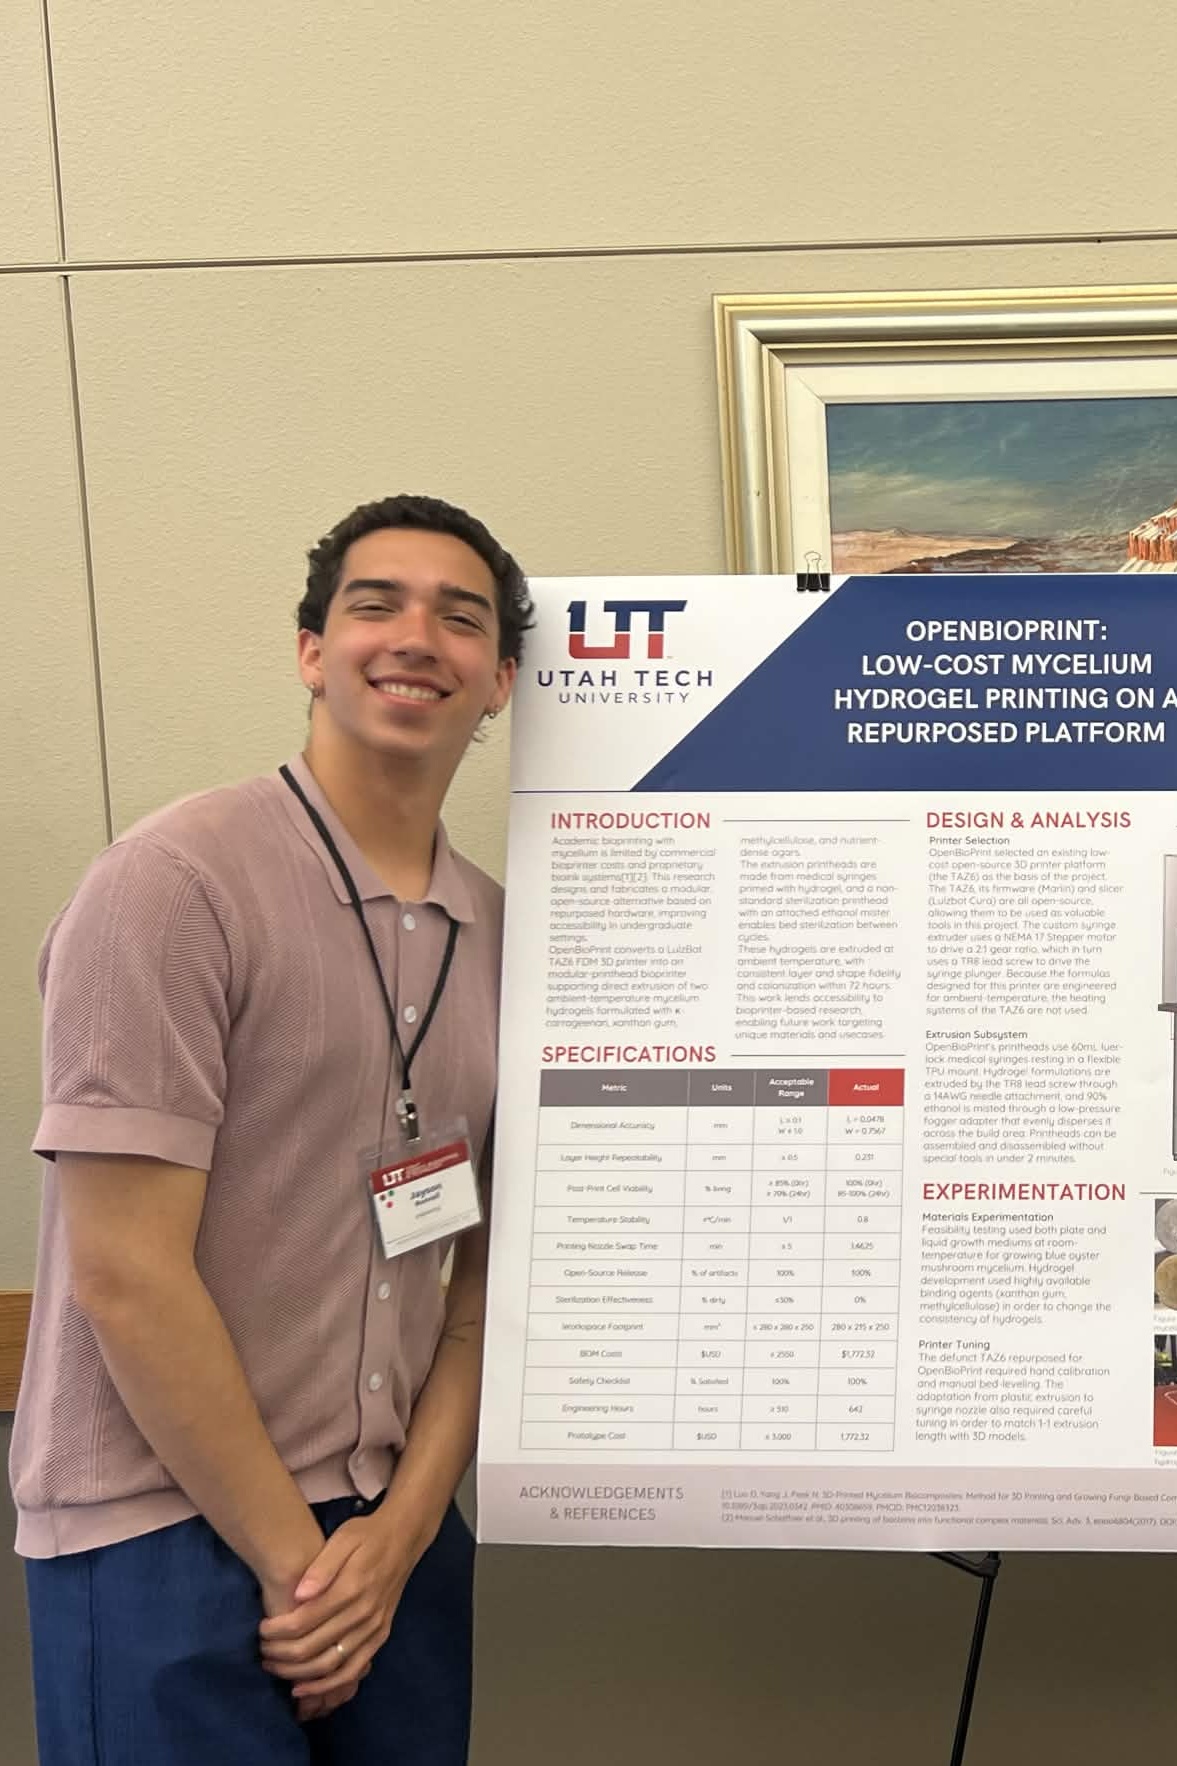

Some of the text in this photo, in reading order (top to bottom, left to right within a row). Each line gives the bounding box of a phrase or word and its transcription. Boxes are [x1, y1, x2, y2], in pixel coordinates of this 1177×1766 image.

[906, 619, 1106, 641] OPENBIOPRINT:
[862, 653, 1151, 675] LOW-COST MYCELIUM
[537, 670, 711, 687] UTAH TECH
[558, 692, 688, 703] UNIVERSITY
[835, 687, 978, 709] HYDROGEL
[986, 687, 1108, 709] PRINTING
[1116, 687, 1153, 708] ON
[848, 721, 1164, 744] REPURPOSED PLATFORM
[551, 811, 709, 829] INTRODUCTION
[927, 811, 1130, 828] DESIGN & ANALYSIS
[929, 835, 1010, 844] Printer Selection
[925, 1029, 1027, 1041] Extrusion Subsystem
[541, 1045, 715, 1063] SPECIFICATIONS
[600, 1083, 628, 1092] Metric
[710, 1083, 733, 1092] Units
[769, 1078, 814, 1088] Acceptable
[852, 1082, 880, 1091] Actual
[778, 1089, 804, 1098] Range
[923, 1183, 1125, 1200] EXPERIMENTATION
[922, 1211, 1053, 1224] Materials Experimentation
[918, 1339, 990, 1351] Printer Tuning
[519, 1484, 683, 1502] ACKNOWLEDGEMENTS
[549, 1502, 655, 1521] & REFERENCES
